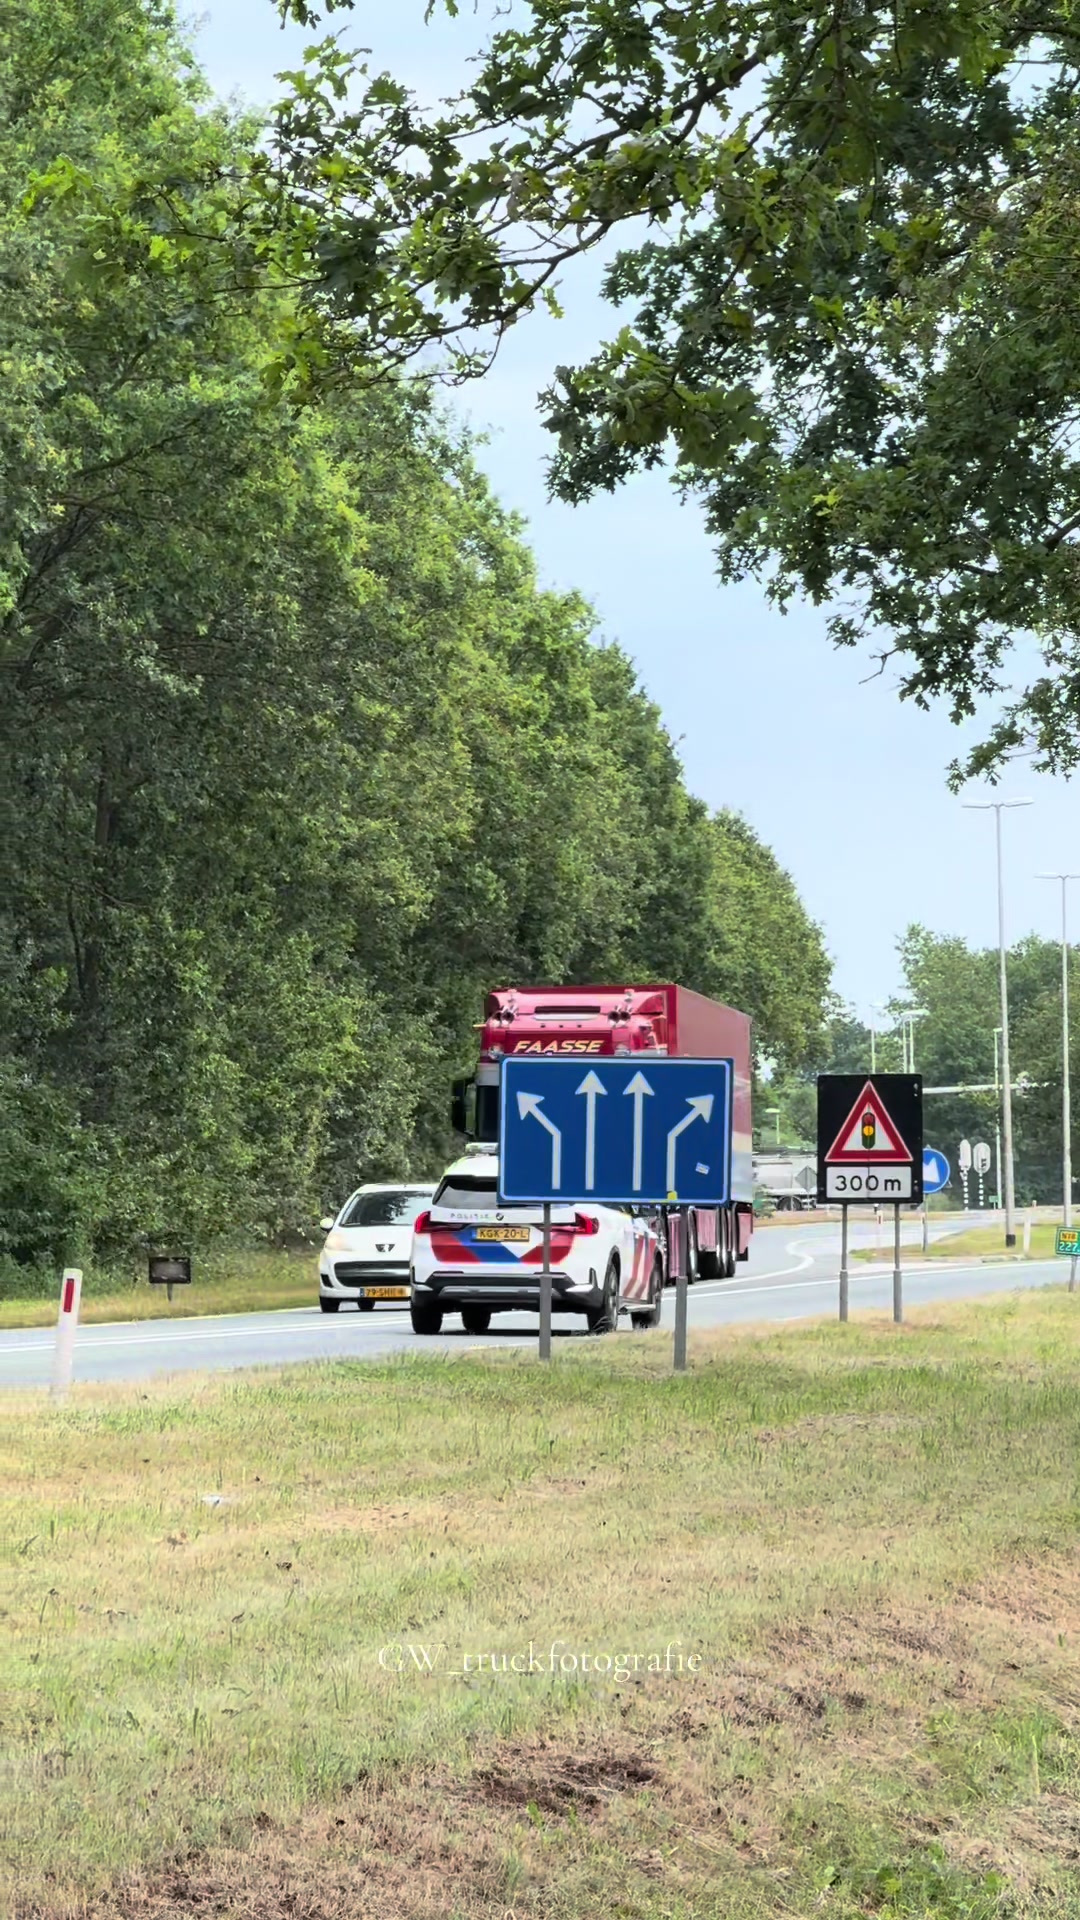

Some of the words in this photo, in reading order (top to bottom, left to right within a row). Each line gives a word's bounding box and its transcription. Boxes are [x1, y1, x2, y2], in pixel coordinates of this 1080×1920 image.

[513, 1040, 604, 1053] FAASSE
[835, 1175, 879, 1191] 300
[884, 1178, 902, 1191] m
